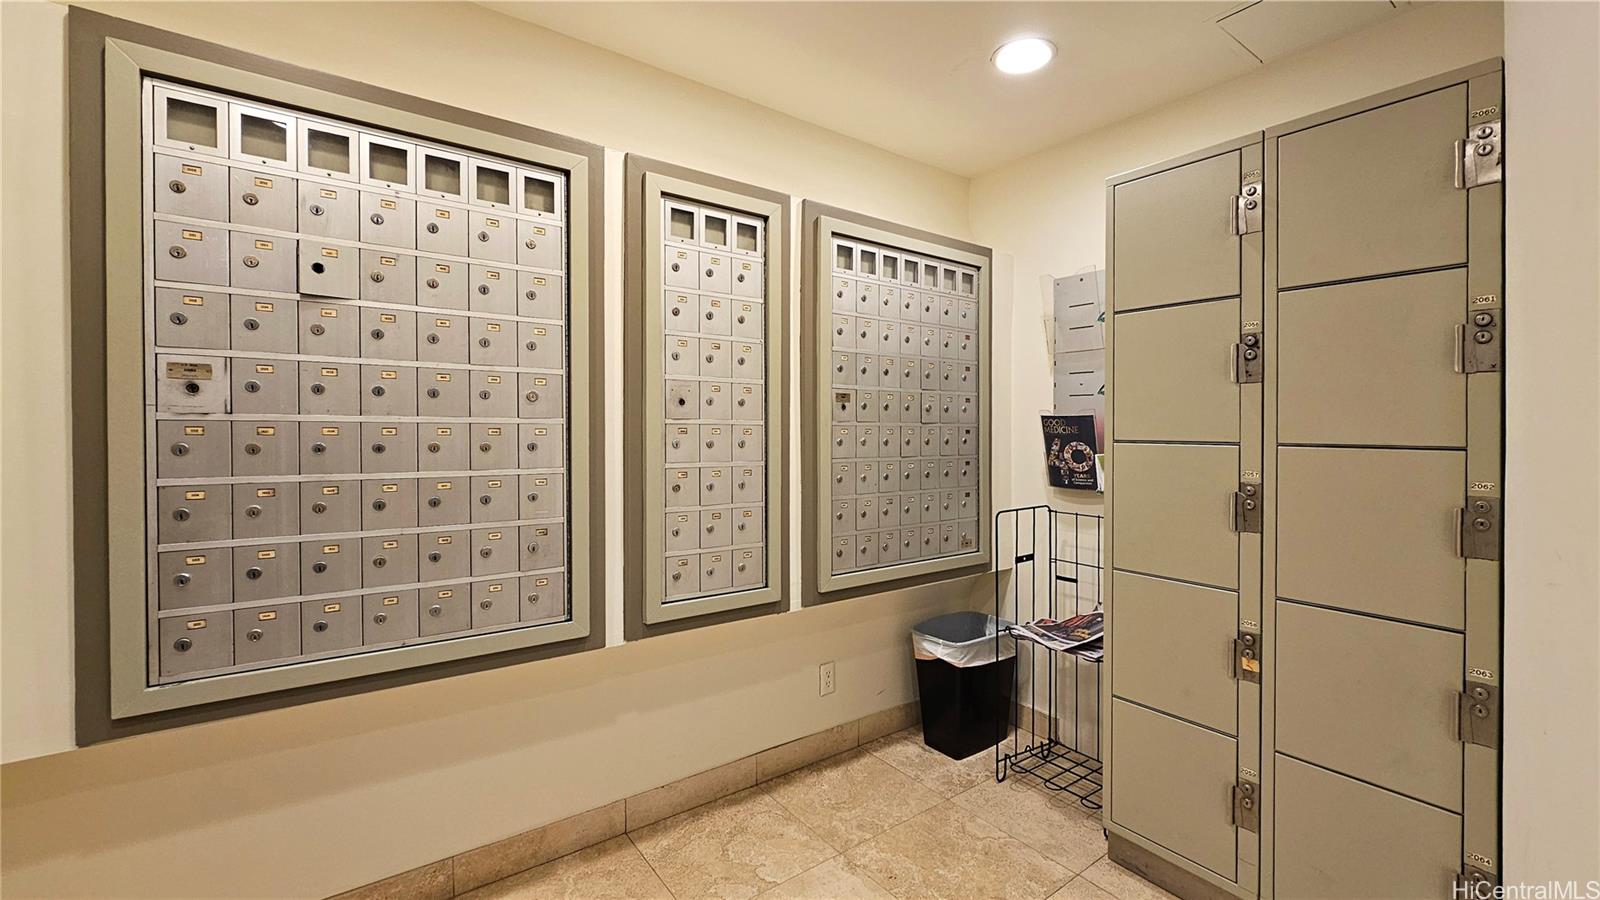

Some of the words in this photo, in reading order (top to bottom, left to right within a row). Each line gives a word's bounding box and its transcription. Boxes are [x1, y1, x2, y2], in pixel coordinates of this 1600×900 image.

[1472, 107, 1496, 118] 2060
[1472, 296, 1496, 304] 2061
[1043, 418, 1066, 426] GOOD
[1044, 426, 1080, 434] MEDICINE
[1471, 482, 1495, 490] 2062
[1470, 668, 1494, 679] 2063
[1467, 853, 1491, 865] 2064
